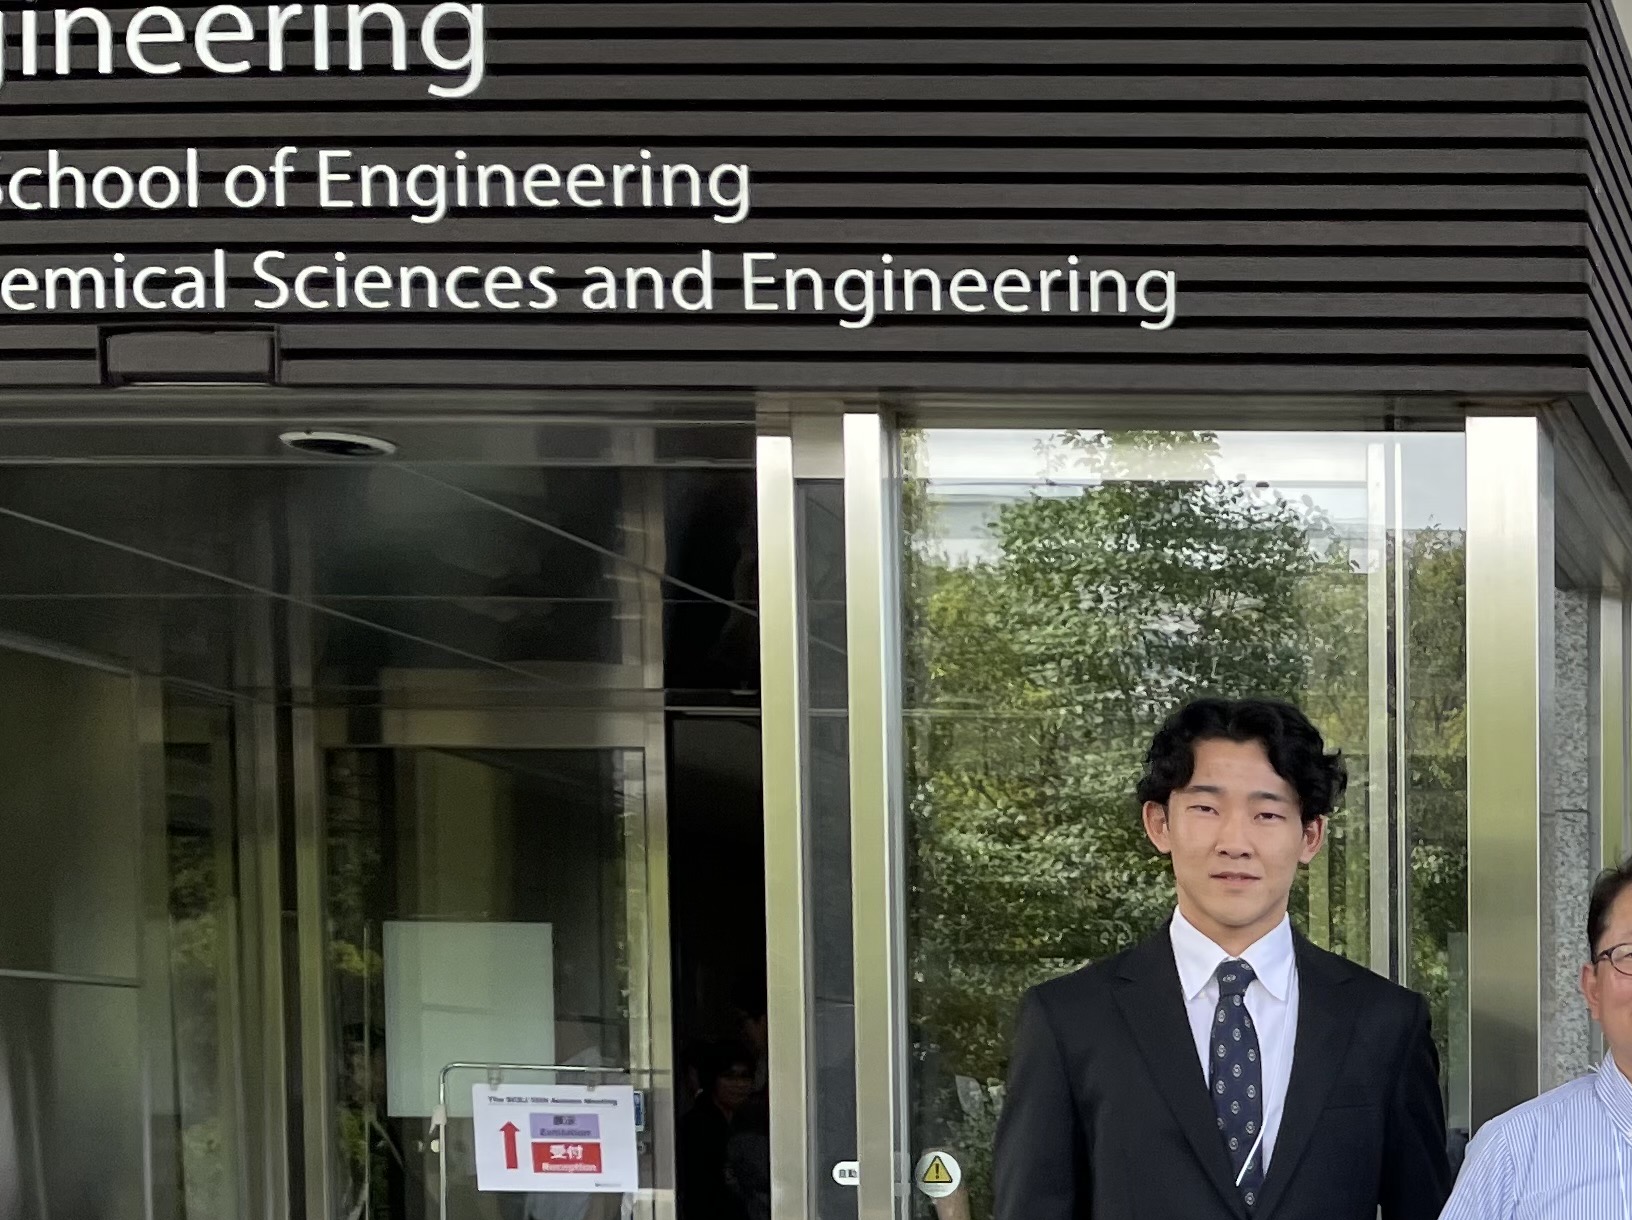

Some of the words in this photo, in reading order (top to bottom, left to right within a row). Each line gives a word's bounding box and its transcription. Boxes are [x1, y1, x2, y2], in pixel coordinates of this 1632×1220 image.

[0, 2, 485, 98] ineering
[0, 147, 199, 210] chool
[224, 146, 298, 208] of
[318, 149, 750, 224] Engineering
[253, 250, 559, 310] Sciences
[582, 249, 713, 311] and
[742, 252, 1177, 330] Engineering
[549, 1144, 584, 1160] 受付
